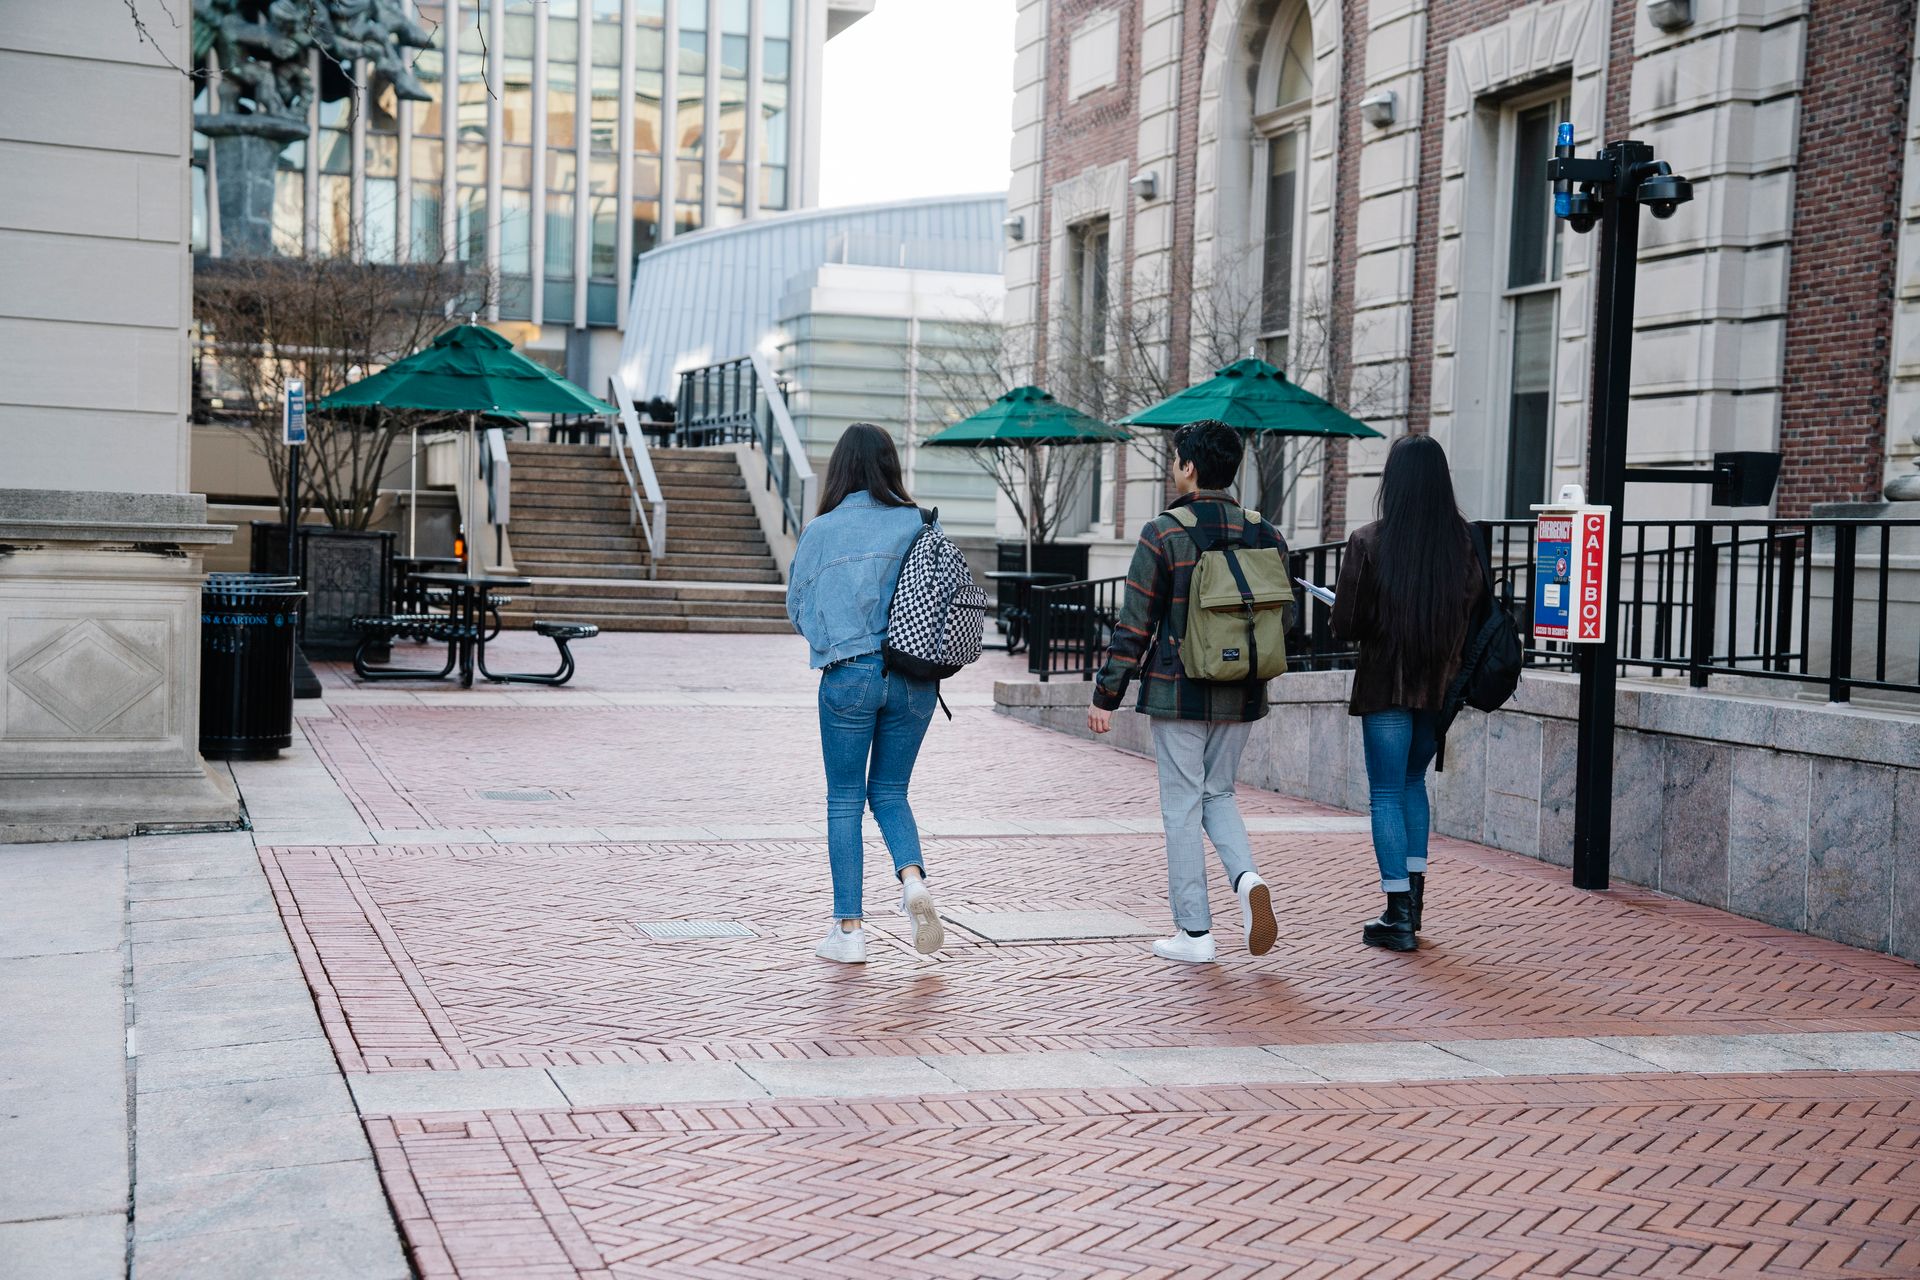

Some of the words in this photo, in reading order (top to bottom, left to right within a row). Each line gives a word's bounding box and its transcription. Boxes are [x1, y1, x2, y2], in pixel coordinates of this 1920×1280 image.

[1583, 517, 1601, 636] CALLBOX
[213, 615, 220, 624] &
[222, 615, 268, 624] CARTONS
